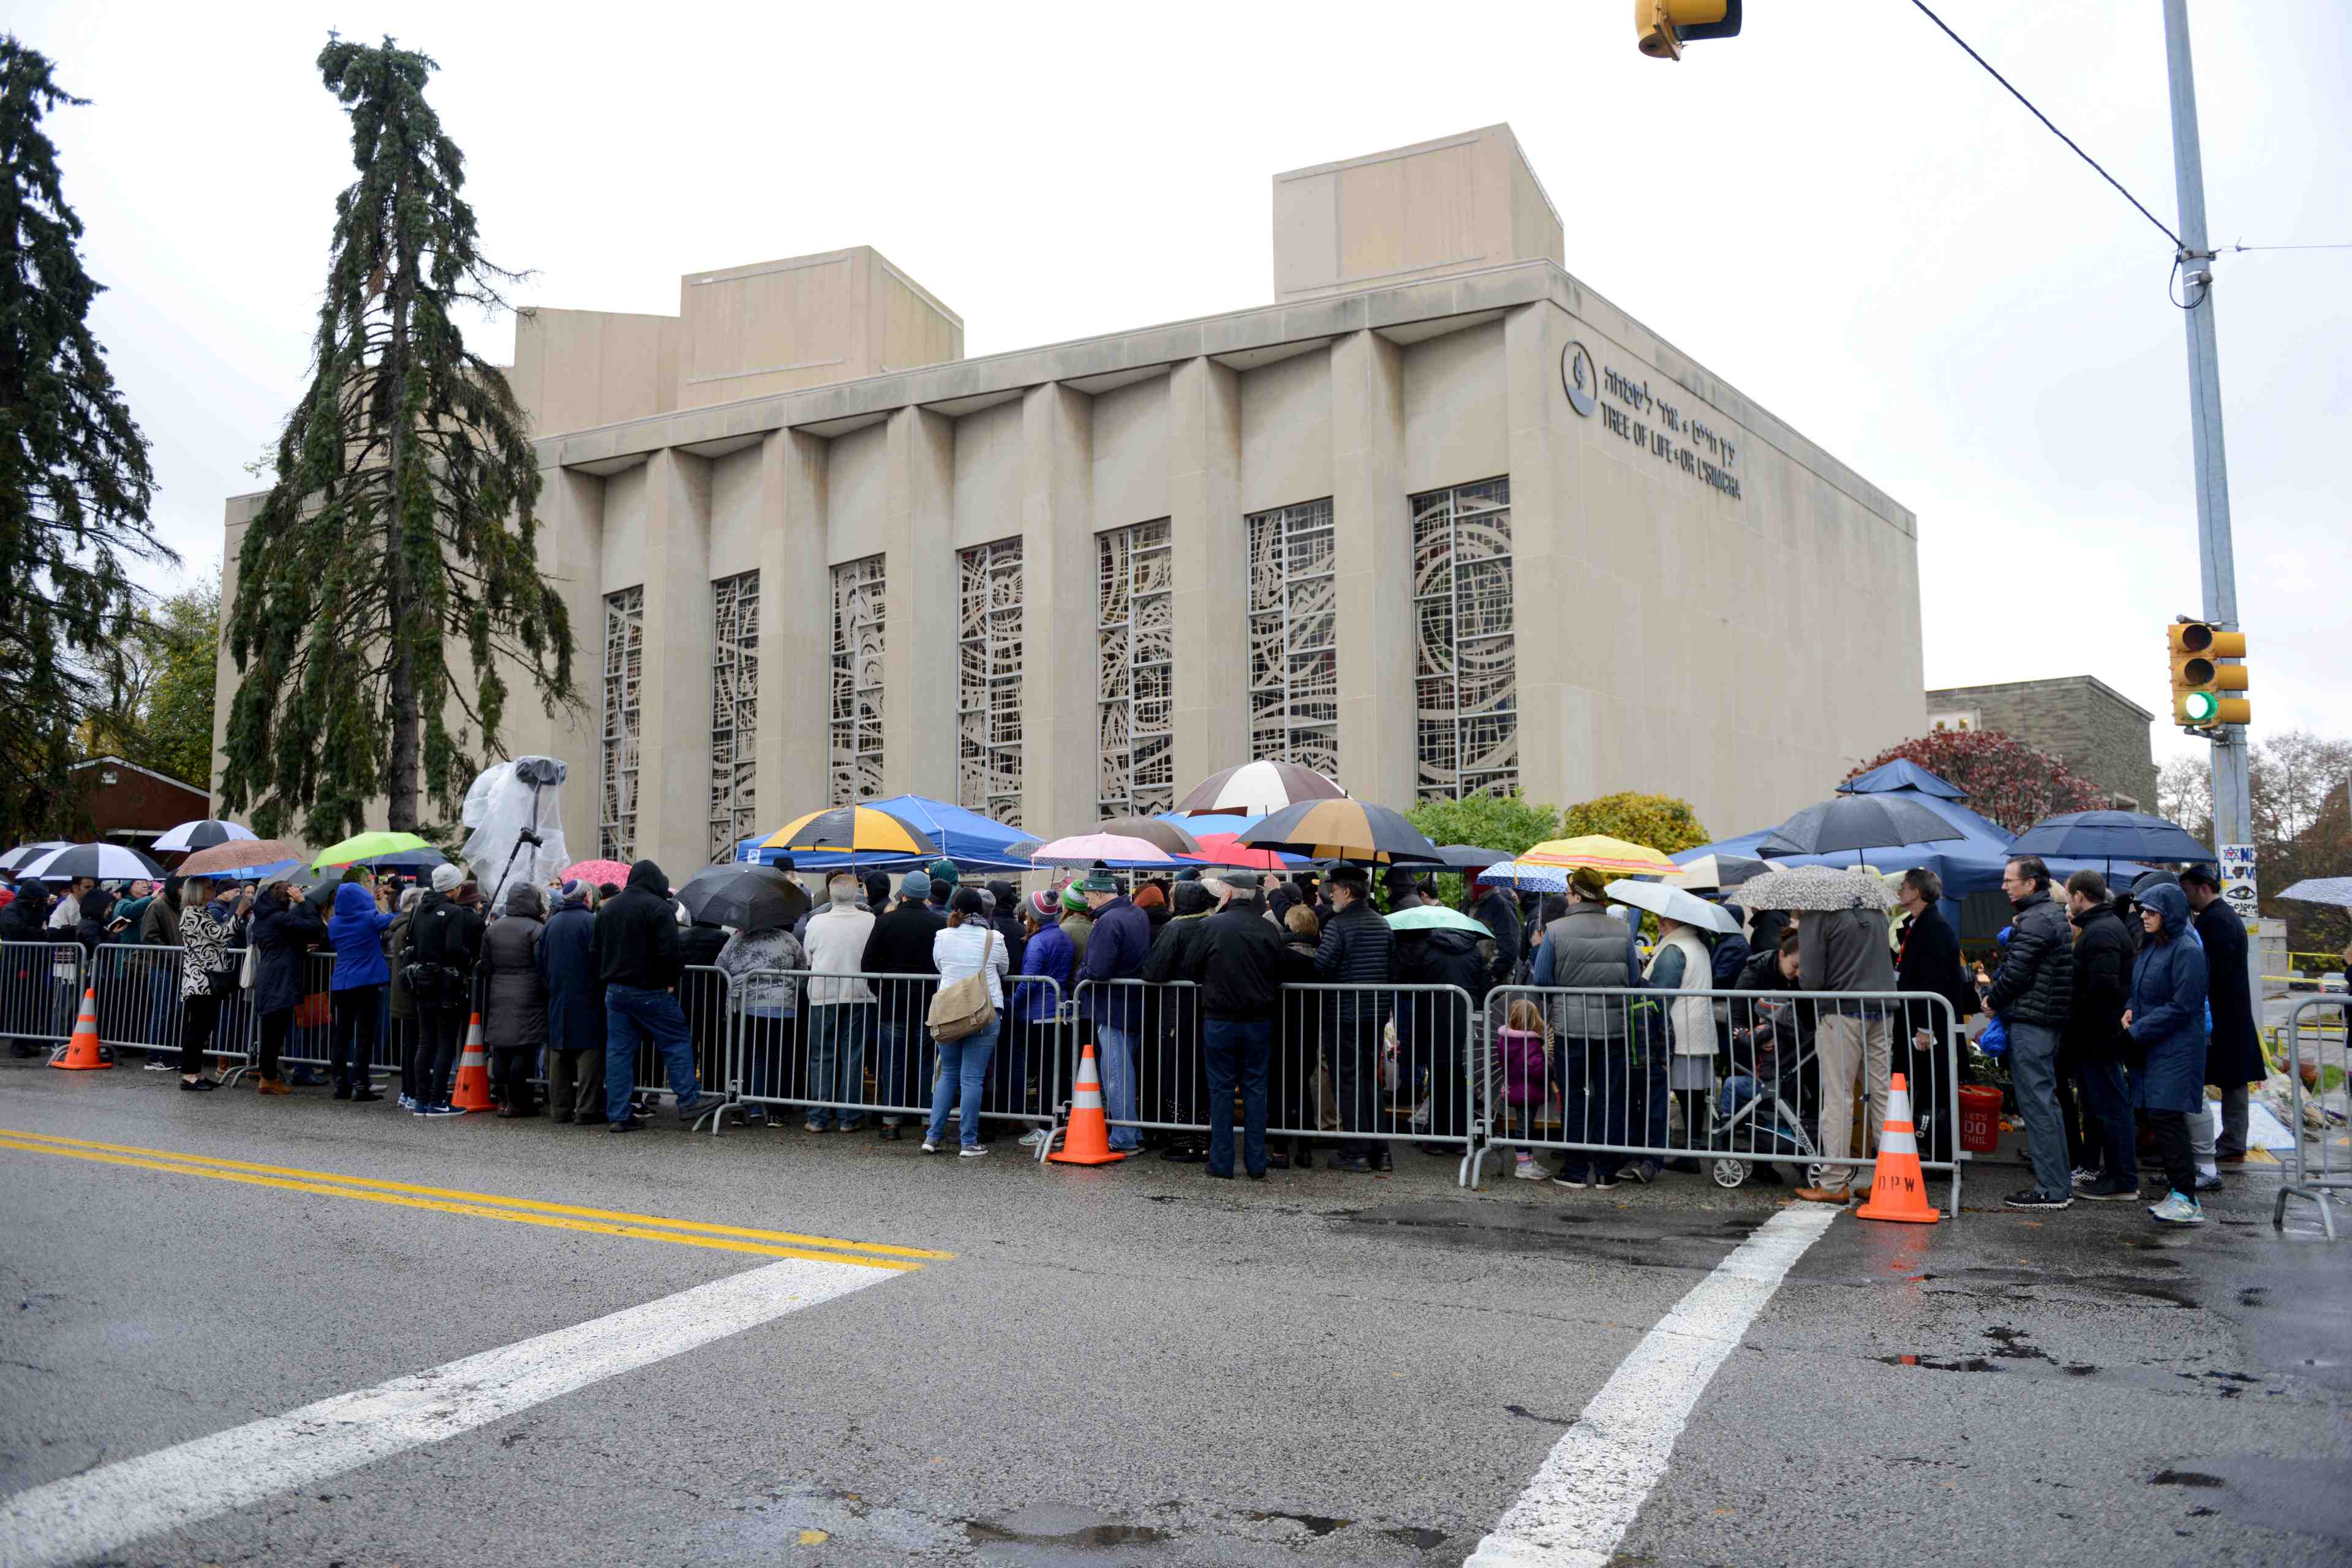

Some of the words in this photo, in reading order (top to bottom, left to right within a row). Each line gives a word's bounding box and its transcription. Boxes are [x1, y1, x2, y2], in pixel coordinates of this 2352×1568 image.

[1600, 401, 1630, 440] TREE
[1634, 421, 1648, 448] OF
[1651, 430, 1672, 464] LIFE
[1681, 448, 1695, 475] OR
[1964, 1120, 1987, 1135] DO
